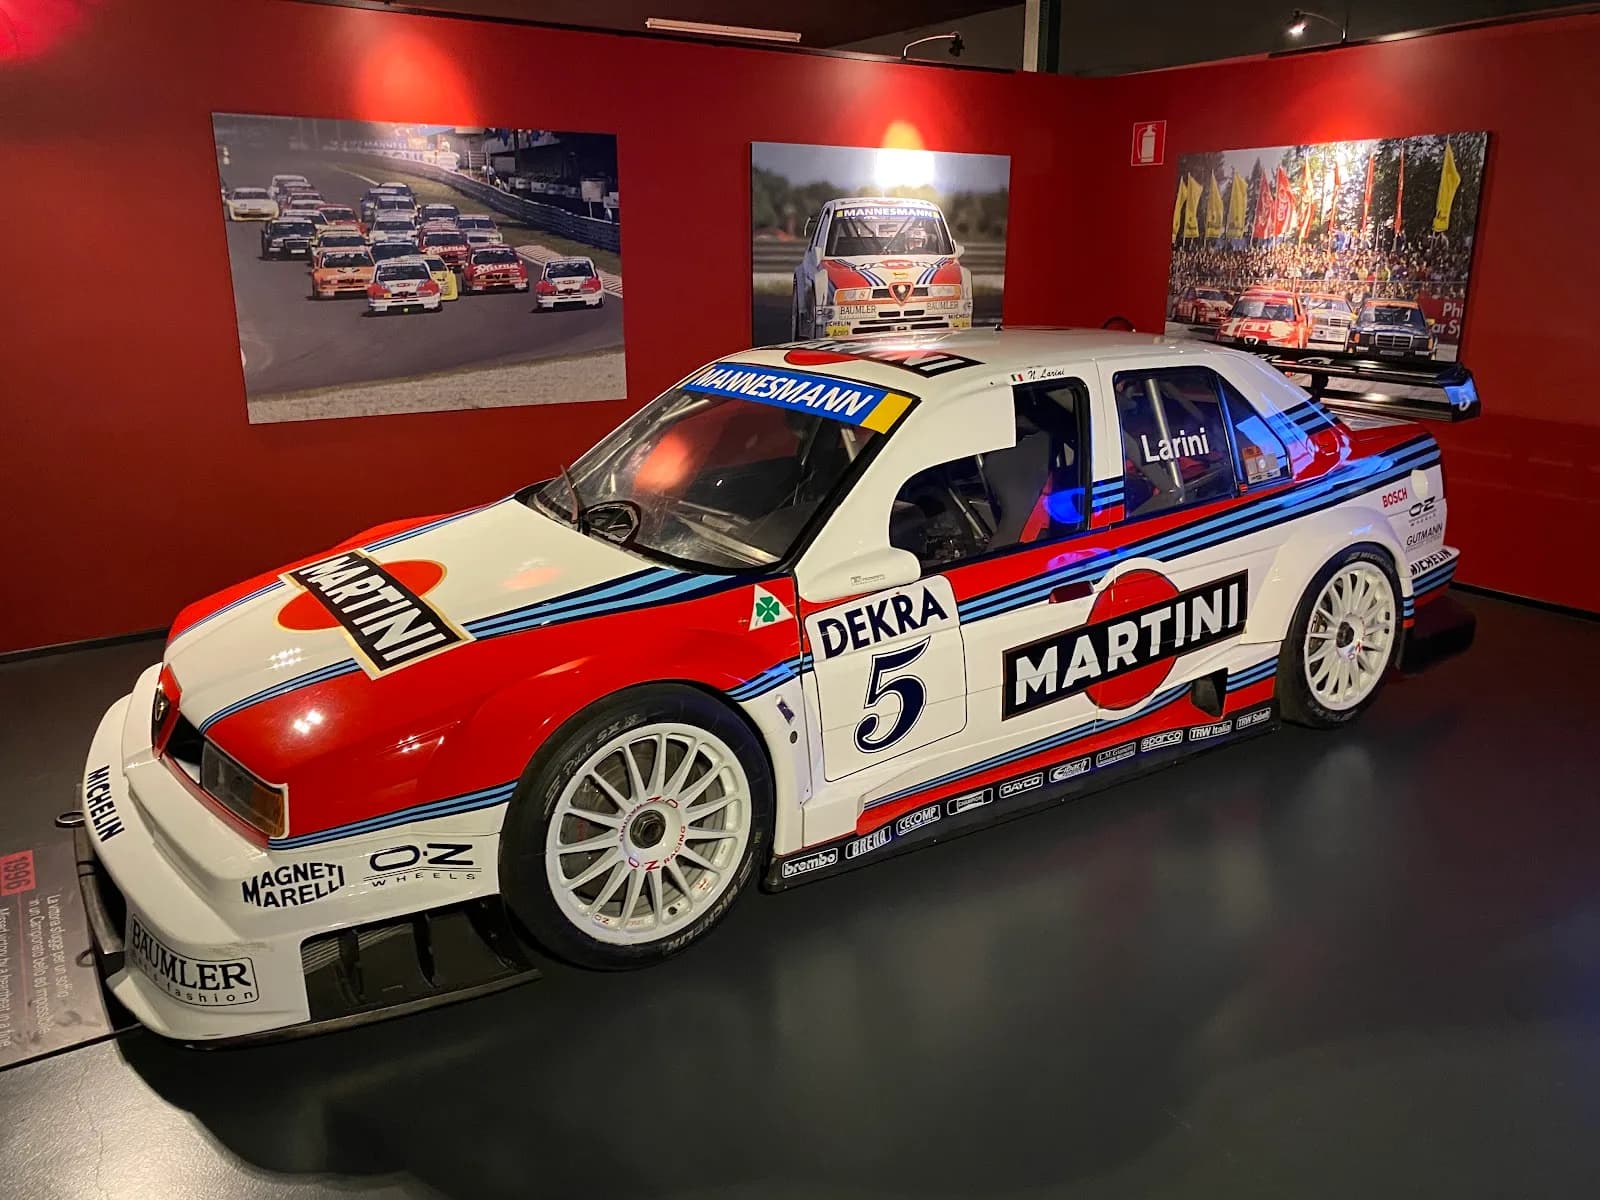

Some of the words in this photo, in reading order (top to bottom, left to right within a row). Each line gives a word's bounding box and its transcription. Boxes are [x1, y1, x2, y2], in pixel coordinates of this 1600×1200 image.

[843, 208, 932, 217] MANNESMANN
[1431, 323, 1446, 334] ar
[693, 368, 874, 418] MANNESMANN
[1140, 427, 1210, 463] Larini
[1382, 487, 1408, 508] BOSCH
[1406, 523, 1443, 546] GUTMANN
[1410, 549, 1453, 576] MICHELIN
[299, 555, 447, 662] MARTINI
[817, 586, 949, 660] DEKRA
[1015, 583, 1239, 706] MARTINI
[854, 636, 931, 754] 5
[1191, 726, 1212, 739] TRW
[1212, 722, 1231, 735] Italia
[1002, 776, 1041, 795] DAYCO
[86, 764, 126, 843] MICHELIN
[899, 807, 938, 831] CECOMP
[3, 855, 32, 890] 1996
[784, 852, 837, 876] brembo
[241, 862, 345, 904] MAGNETI
[241, 872, 345, 908] MARELLI
[371, 872, 476, 888] WHEELS
[28, 906, 41, 917] un
[27, 915, 46, 957] Campionato
[47, 927, 66, 951] sfugge
[32, 956, 49, 977] bello
[50, 951, 65, 963] per
[132, 918, 252, 991] BAUMLER
[34, 976, 51, 988] ed
[54, 964, 66, 976] un
[55, 975, 72, 998] soffio
[167, 981, 254, 1003] fashion
